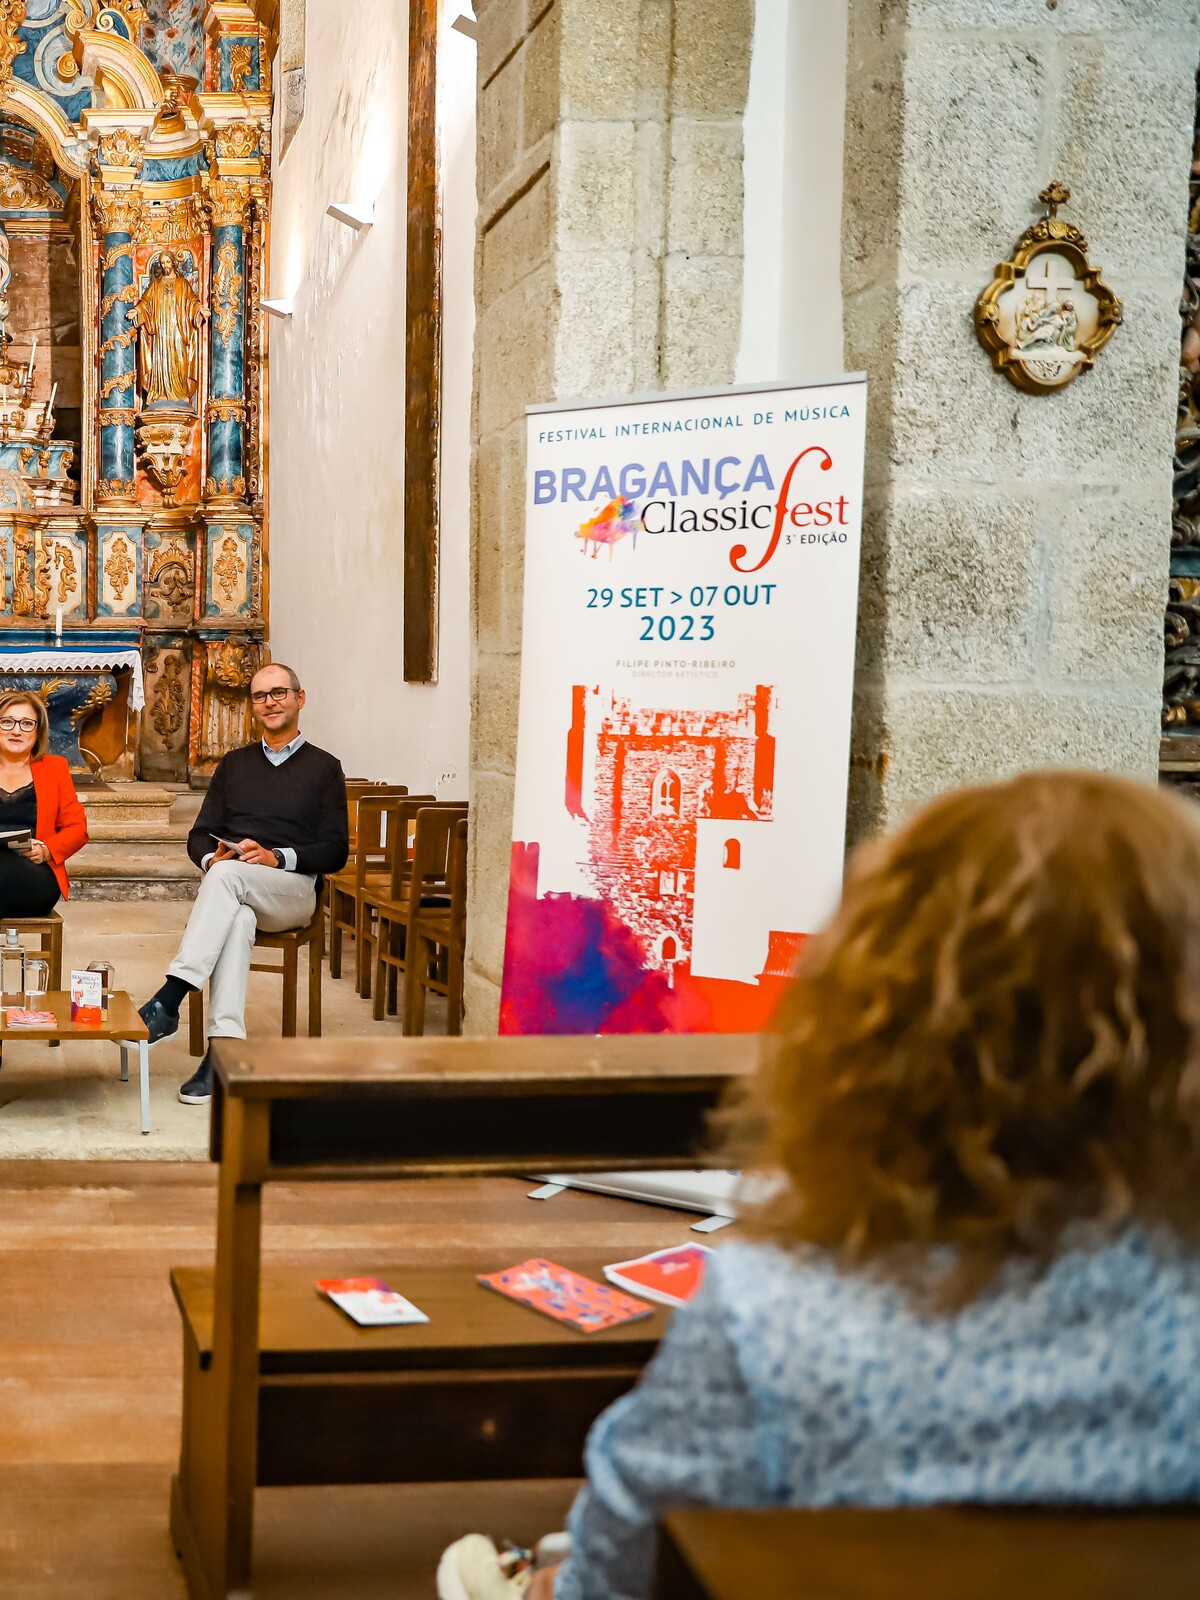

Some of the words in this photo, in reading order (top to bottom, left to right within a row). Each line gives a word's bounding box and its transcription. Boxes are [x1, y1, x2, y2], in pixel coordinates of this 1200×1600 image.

[539, 428, 606, 443] FESTIVAL
[615, 416, 743, 437] INTERNACIONAL
[753, 412, 774, 425] DE
[784, 405, 850, 422] MÚSICA
[534, 454, 775, 505] BRAGANÇA
[800, 531, 848, 546] EDIÇÃO
[586, 588, 613, 608] 29
[620, 587, 663, 608] SET
[690, 586, 718, 606] 07
[724, 584, 776, 606] OUT
[639, 615, 716, 641] 2023
[616, 660, 649, 668] FILIPE
[654, 660, 736, 668] PINTO-RIBEIRO
